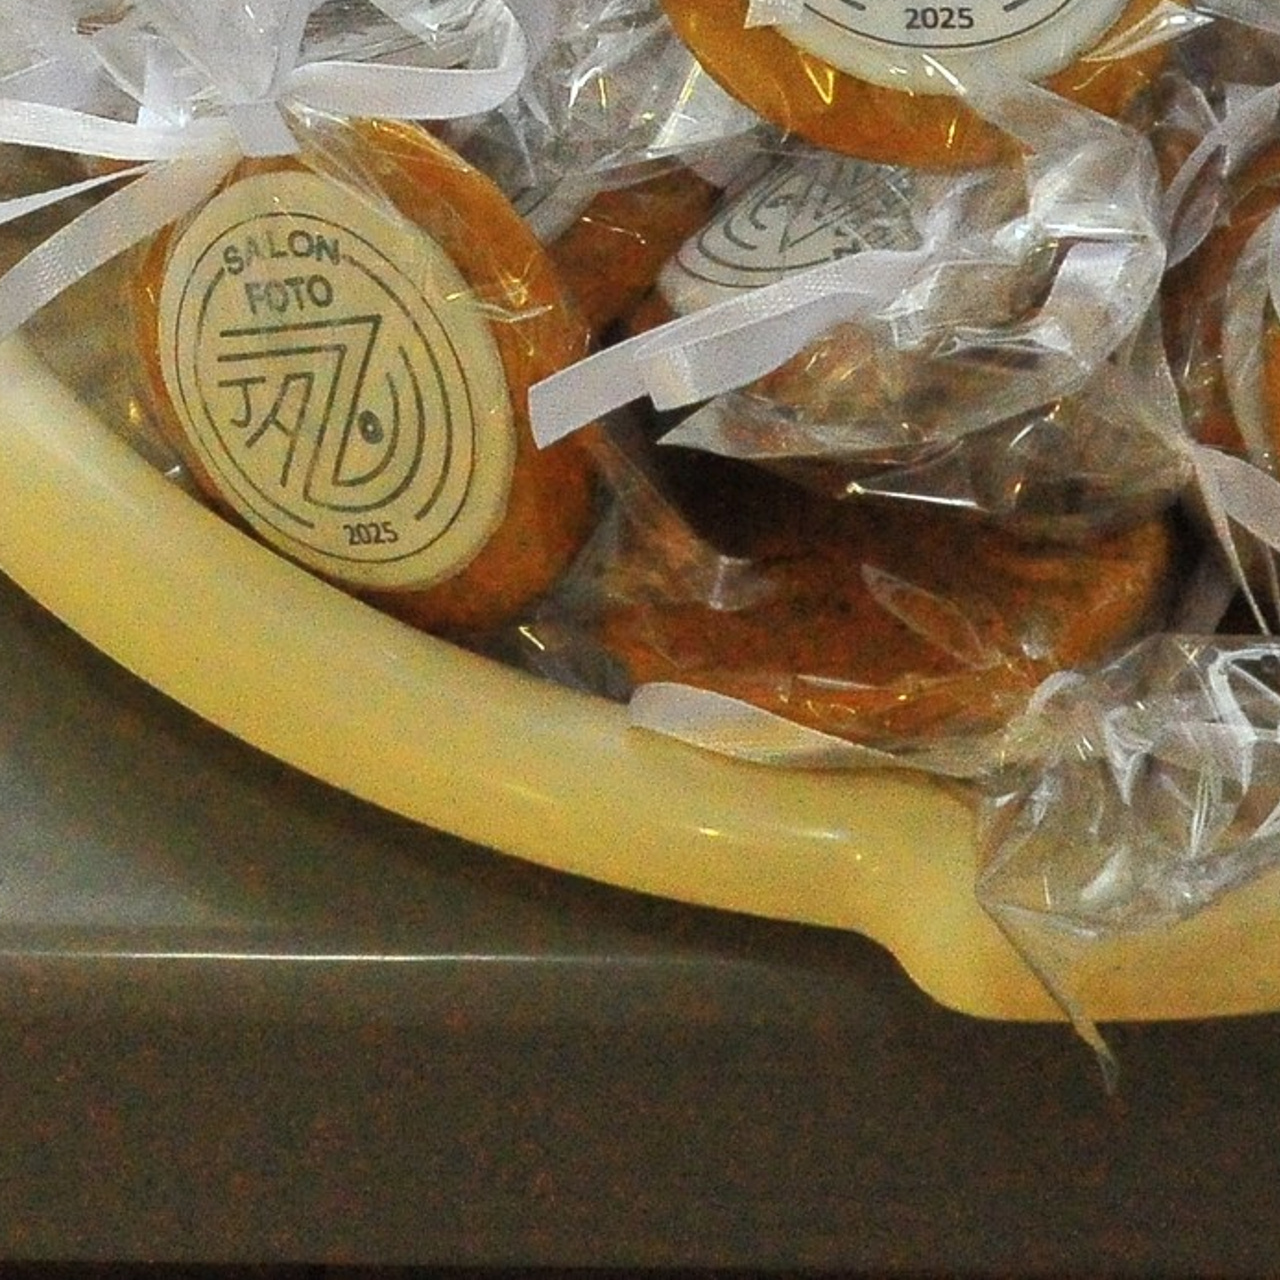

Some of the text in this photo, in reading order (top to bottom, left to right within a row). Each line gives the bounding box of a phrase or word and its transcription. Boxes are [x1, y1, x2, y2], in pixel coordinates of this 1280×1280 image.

[905, 7, 974, 30] 2025
[222, 229, 342, 276] SALON
[243, 274, 334, 314] FOTO
[342, 521, 399, 548] 2025
